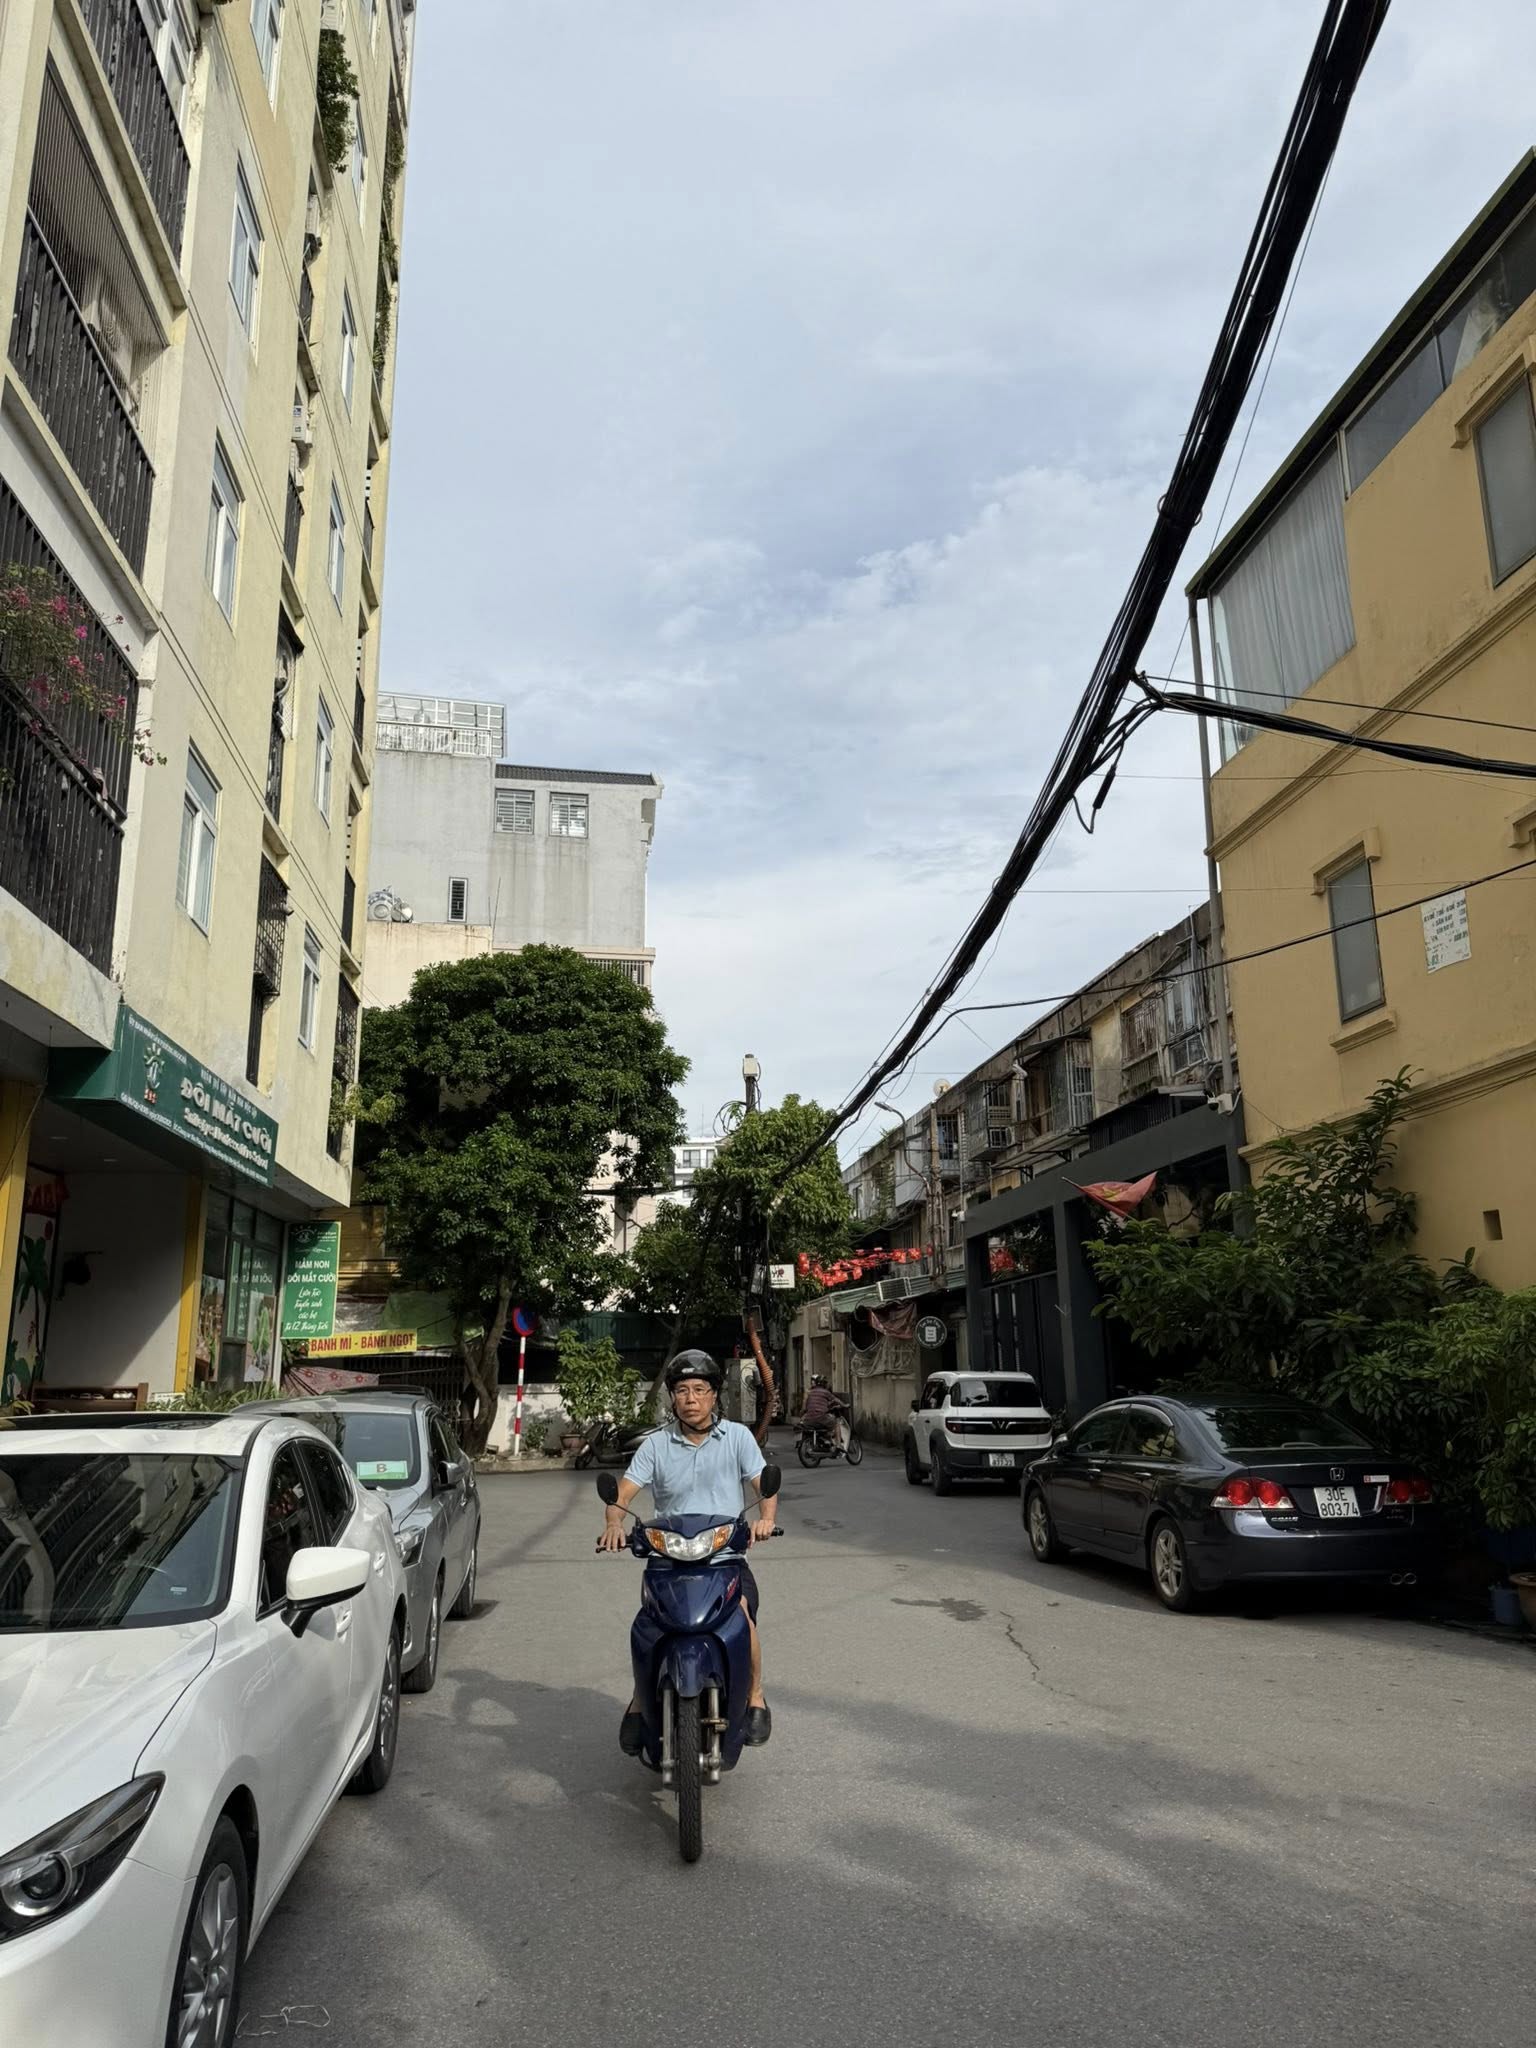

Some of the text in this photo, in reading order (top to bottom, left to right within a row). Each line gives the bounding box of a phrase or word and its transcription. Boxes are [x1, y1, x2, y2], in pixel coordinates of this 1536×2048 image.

[181, 1077, 211, 1112] ĐÔI
[212, 1100, 241, 1133] MẮT
[242, 1121, 272, 1154] CƯỜI
[314, 1260, 330, 1269] NON
[287, 1271, 336, 1283] ĐÔI MẮT CƯỜI
[292, 1321, 301, 1331] 12
[340, 1335, 352, 1350] MÌ
[361, 1333, 387, 1349] BÁNH
[389, 1333, 415, 1350] NGỌT
[376, 1463, 387, 1473] B
[1326, 1487, 1348, 1501] 30E
[1320, 1502, 1360, 1517] 803.74
